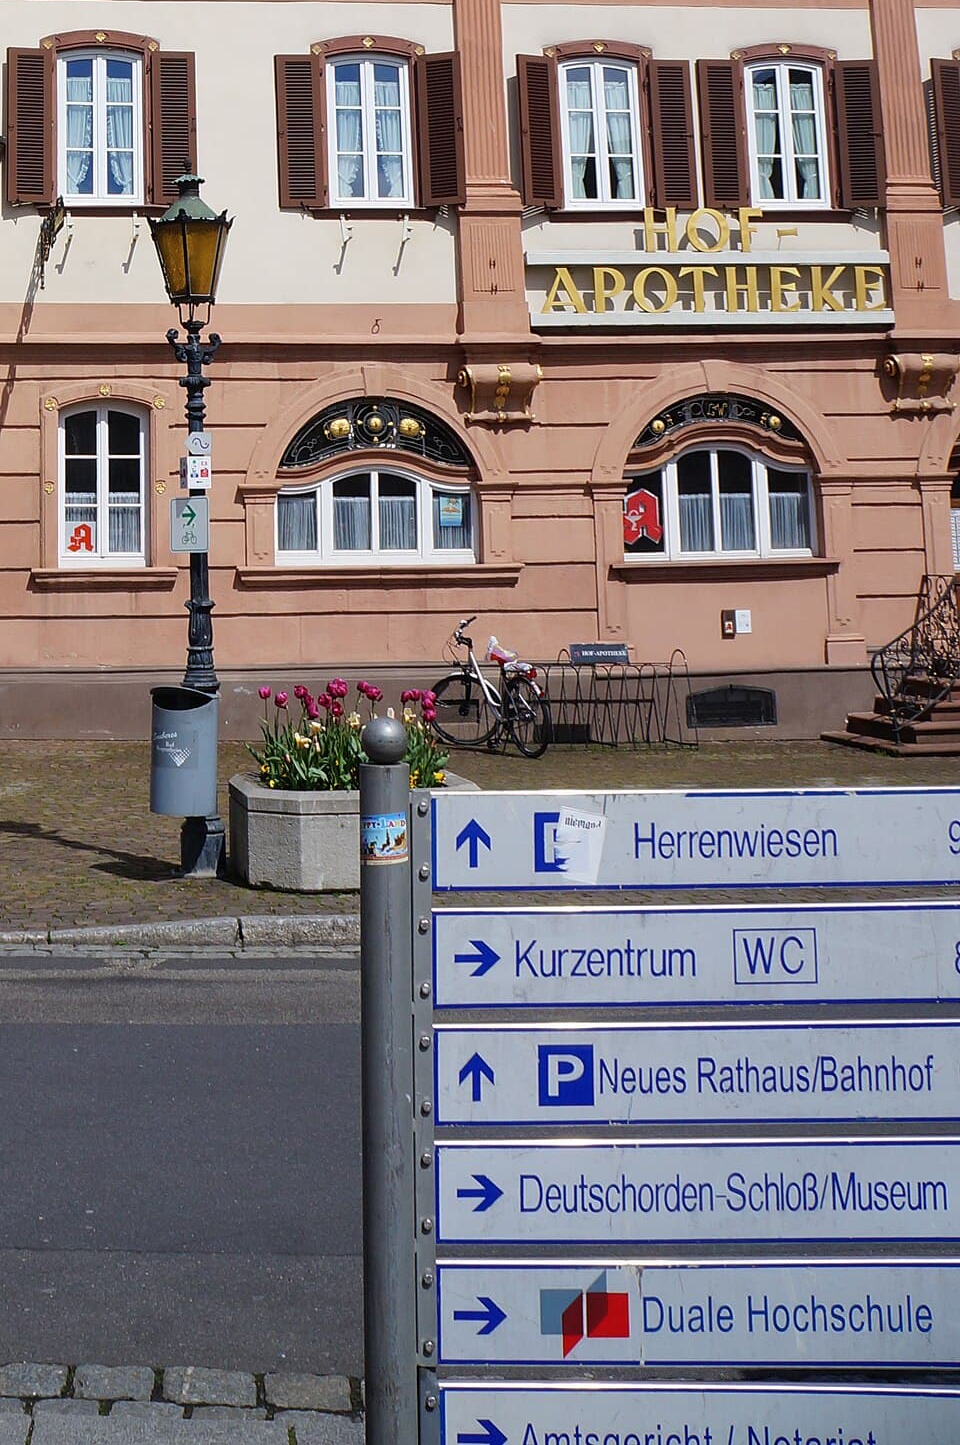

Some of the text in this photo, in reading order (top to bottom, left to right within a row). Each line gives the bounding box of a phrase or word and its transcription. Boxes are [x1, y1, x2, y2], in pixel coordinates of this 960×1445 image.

[541, 265, 886, 313] APOTHEKE
[634, 821, 838, 860] Herrenwiesen
[515, 935, 805, 979] Kurzentrum WC
[599, 1059, 687, 1095] Neues
[697, 1054, 935, 1094] Rathaus/Bahnhof
[519, 1171, 948, 1214] Deutschorden-Schloß/Museum
[642, 1294, 935, 1334] Duale Hochschule
